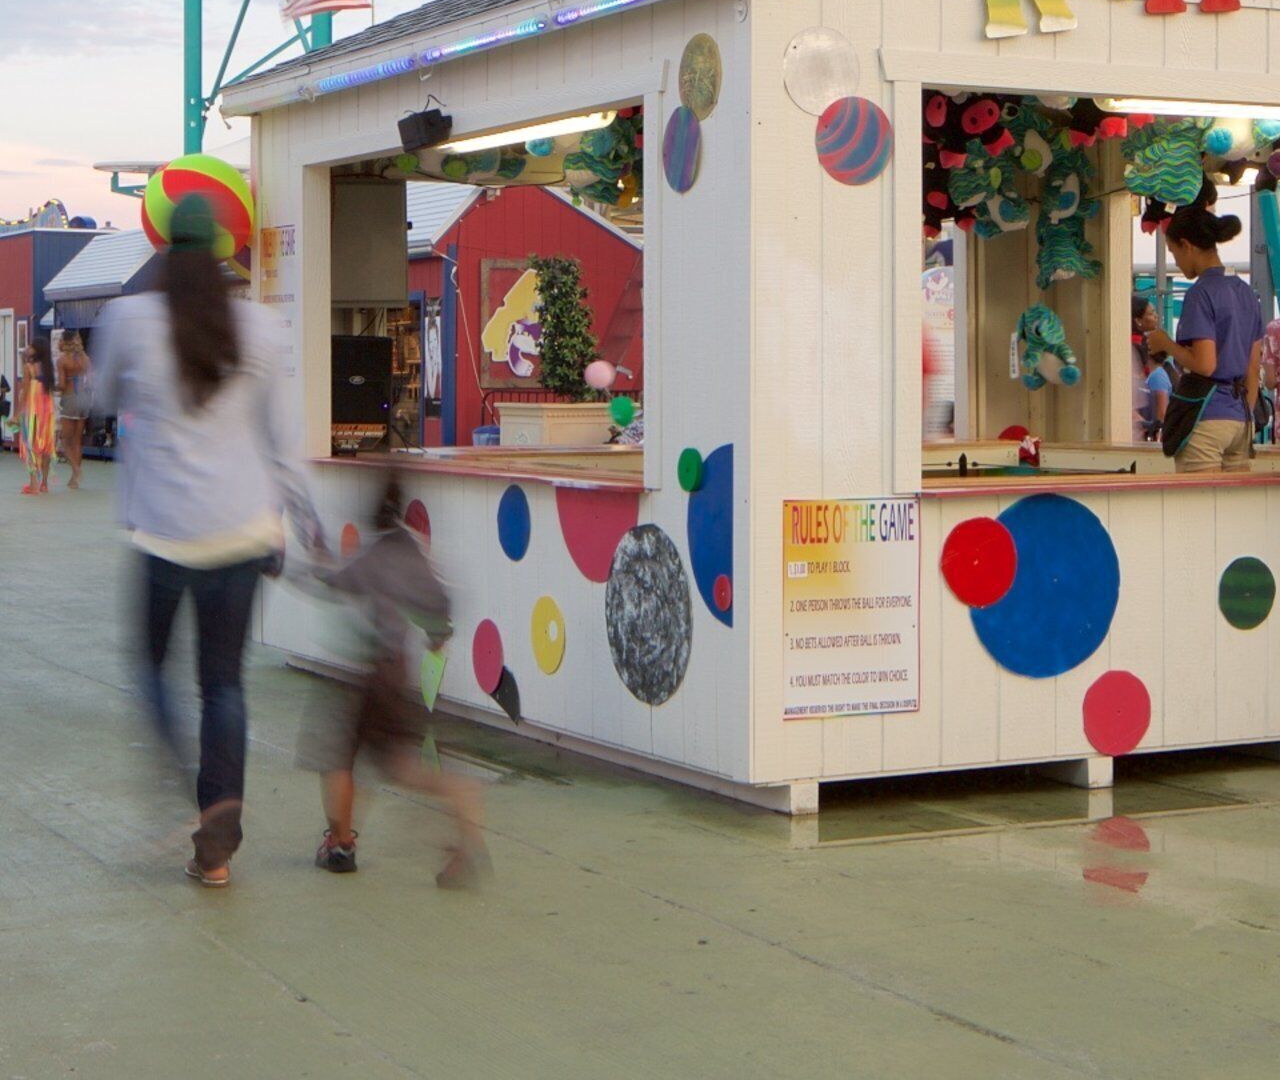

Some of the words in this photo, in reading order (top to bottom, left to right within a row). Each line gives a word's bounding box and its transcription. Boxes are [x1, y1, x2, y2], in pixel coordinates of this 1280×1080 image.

[791, 503, 829, 545] RULES
[832, 503, 849, 544] OF
[851, 503, 876, 543] THE
[879, 503, 914, 542] GAME
[808, 561, 815, 574] TO
[816, 561, 828, 574] PLAY
[795, 600, 808, 612] ONE
[808, 599, 829, 612] PERSON
[829, 598, 851, 611] THROWS
[851, 597, 862, 610] THE
[862, 597, 874, 609] BALL
[875, 596, 885, 608] FOR
[795, 637, 805, 649] NO
[805, 637, 817, 649] BETS
[818, 636, 843, 649] ALLOWED
[843, 635, 860, 647] AFTER
[860, 634, 873, 647] BALL
[873, 634, 878, 646] IS
[795, 675, 806, 688] YOU
[807, 674, 821, 687] MUST
[821, 673, 840, 686] MATCH
[840, 672, 852, 685] THE
[852, 671, 870, 684] COLOR
[870, 671, 878, 683] TO
[878, 670, 888, 683] WIN
[888, 669, 908, 682] CHOICE
